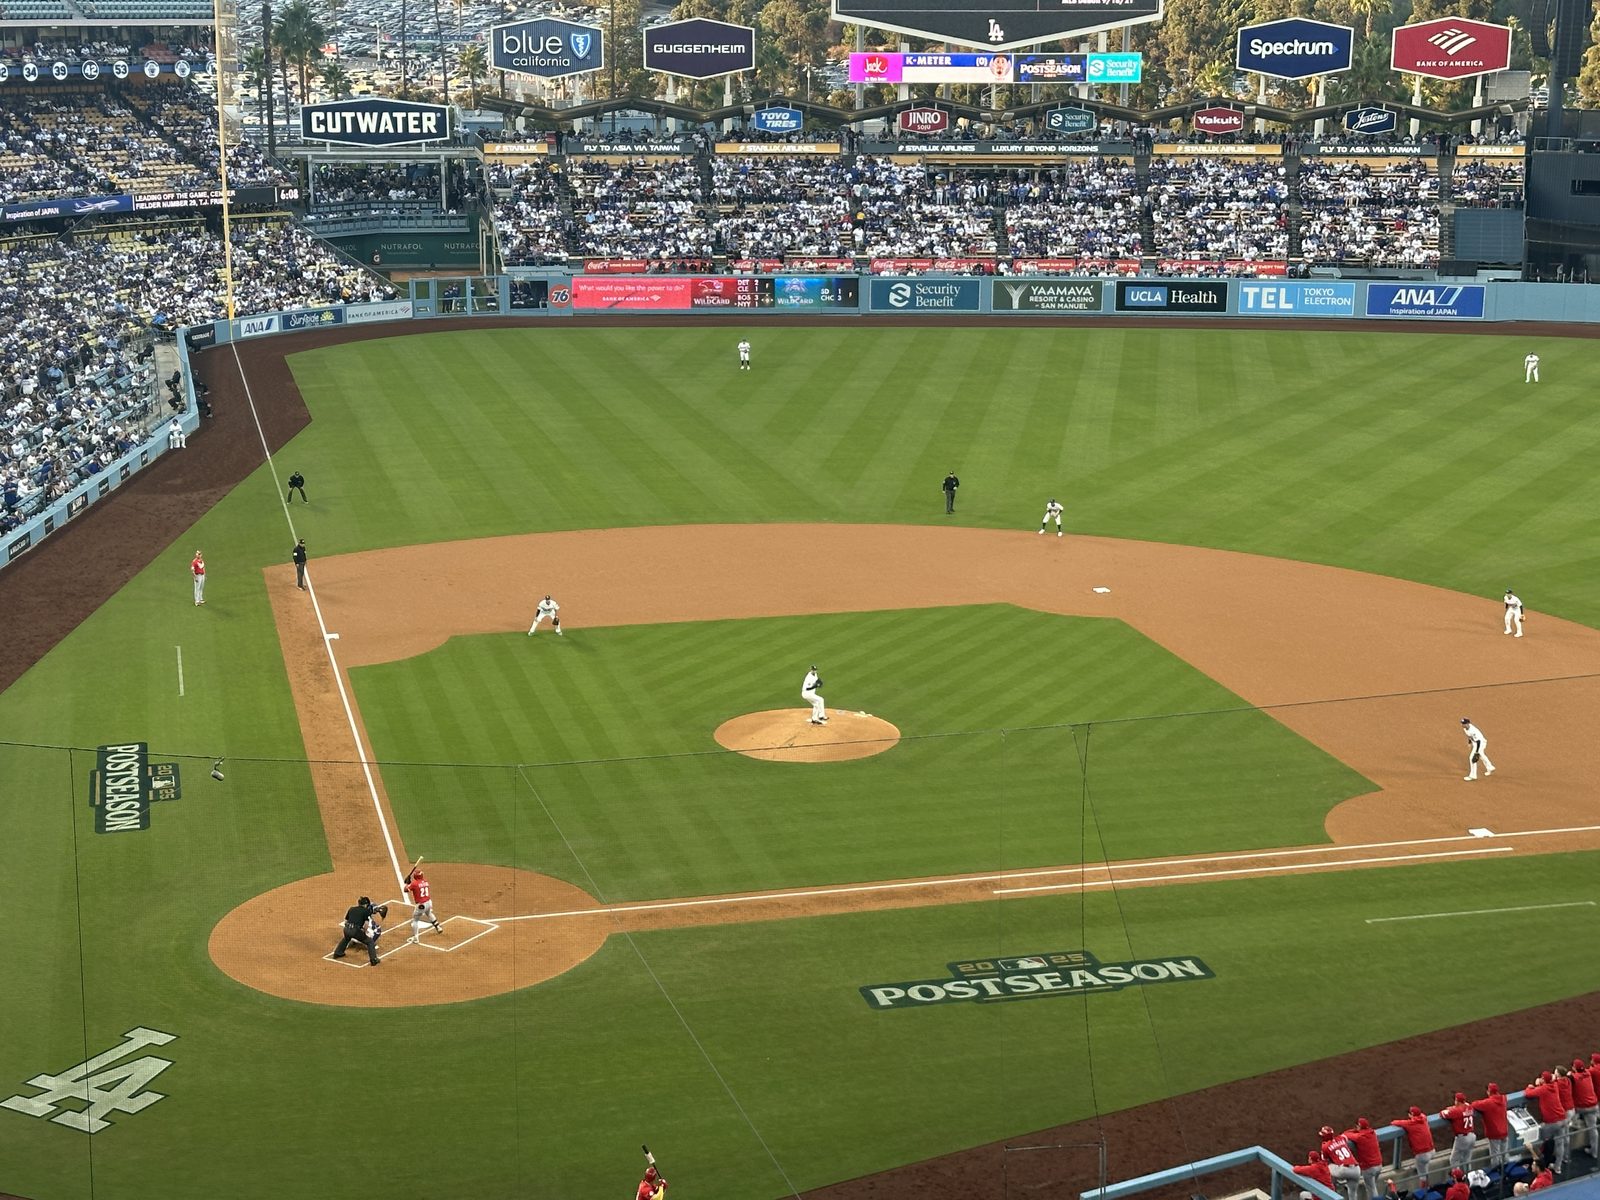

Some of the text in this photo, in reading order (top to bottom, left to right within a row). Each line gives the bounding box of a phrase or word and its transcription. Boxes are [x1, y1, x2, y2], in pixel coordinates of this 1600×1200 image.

[988, 19, 1004, 41] LA
[502, 30, 562, 54] blue
[653, 43, 746, 54] GUGGENHEIM
[1250, 38, 1334, 59] Spectrum
[512, 55, 570, 67] california
[906, 56, 951, 65] K-METER
[1106, 59, 1138, 69] Security
[0, 68, 6, 77] 2
[25, 68, 36, 78] 34
[53, 66, 66, 76] 39
[84, 64, 97, 75] 42
[114, 64, 127, 74] 53
[1020, 64, 1081, 74] POSTSEASON
[311, 111, 438, 133] CUTWATER
[908, 112, 940, 127] JINRO
[1065, 114, 1090, 122] Security
[1197, 116, 1240, 124] Yakult
[280, 189, 299, 199] 6:08
[6, 211, 34, 219] Inspiration
[915, 283, 961, 297] Security
[1304, 288, 1334, 296] TOKYO
[552, 289, 569, 303] 76
[916, 296, 955, 307] Benefit
[1131, 290, 1217, 304] UCLA Health
[1243, 287, 1293, 309] TEL
[1304, 297, 1350, 305] ELECTRON
[1391, 289, 1436, 305] ANA
[1390, 308, 1425, 316] Inspiration
[244, 321, 263, 334] ANA
[105, 744, 140, 831] POSTSEASON
[958, 953, 1085, 972] 20 25
[870, 960, 1205, 1006] POSTSEASON
[0, 1026, 178, 1134] LA
